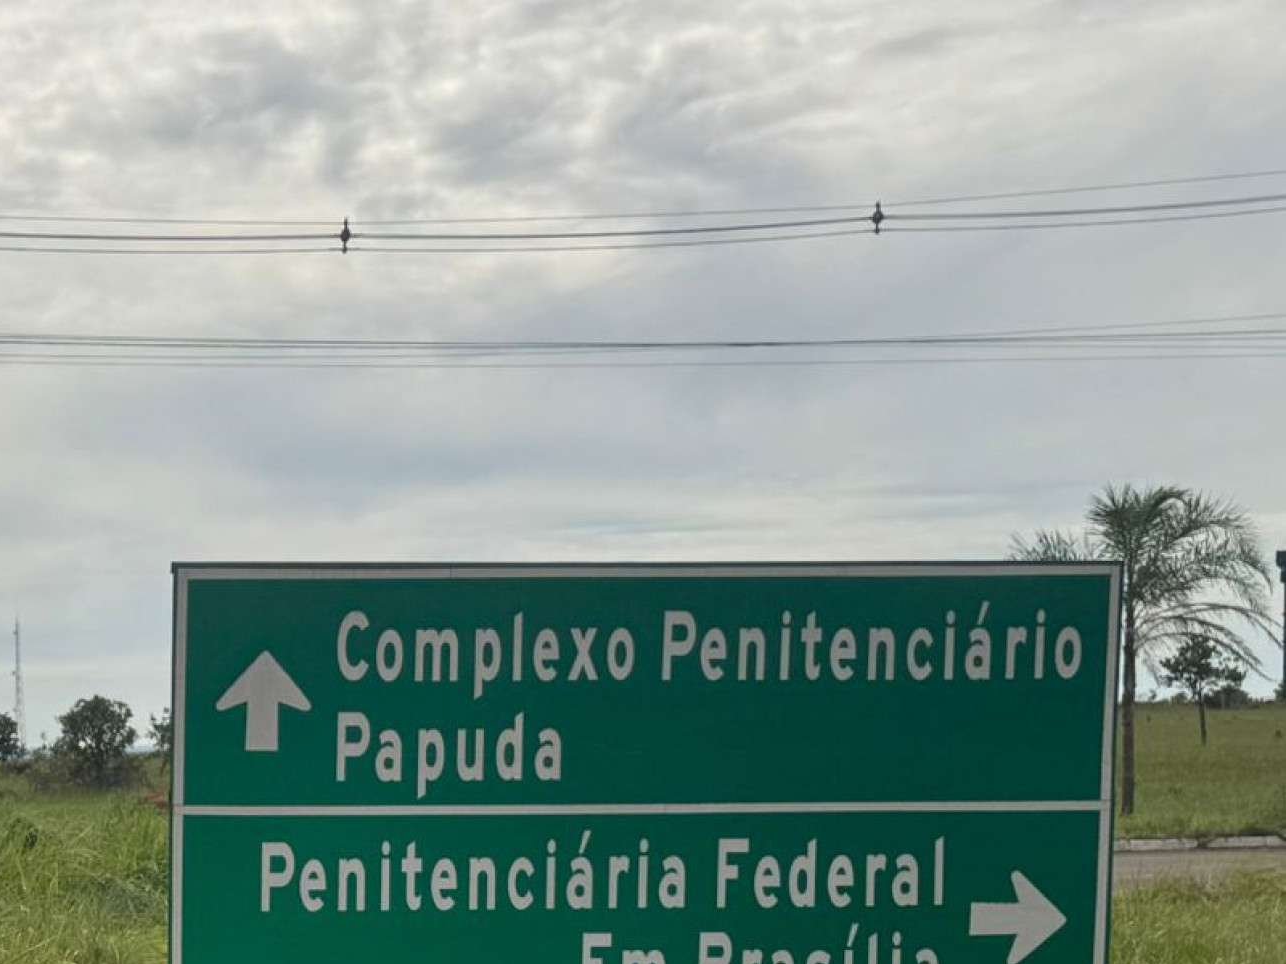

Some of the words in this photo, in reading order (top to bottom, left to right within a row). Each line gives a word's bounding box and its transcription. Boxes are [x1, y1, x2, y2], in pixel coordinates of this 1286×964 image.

[337, 612, 636, 698] Complexo
[663, 602, 1081, 681] Penitenciário
[336, 711, 563, 798] Papuda
[260, 830, 686, 912] Penitenciária
[715, 836, 945, 908] Federal
